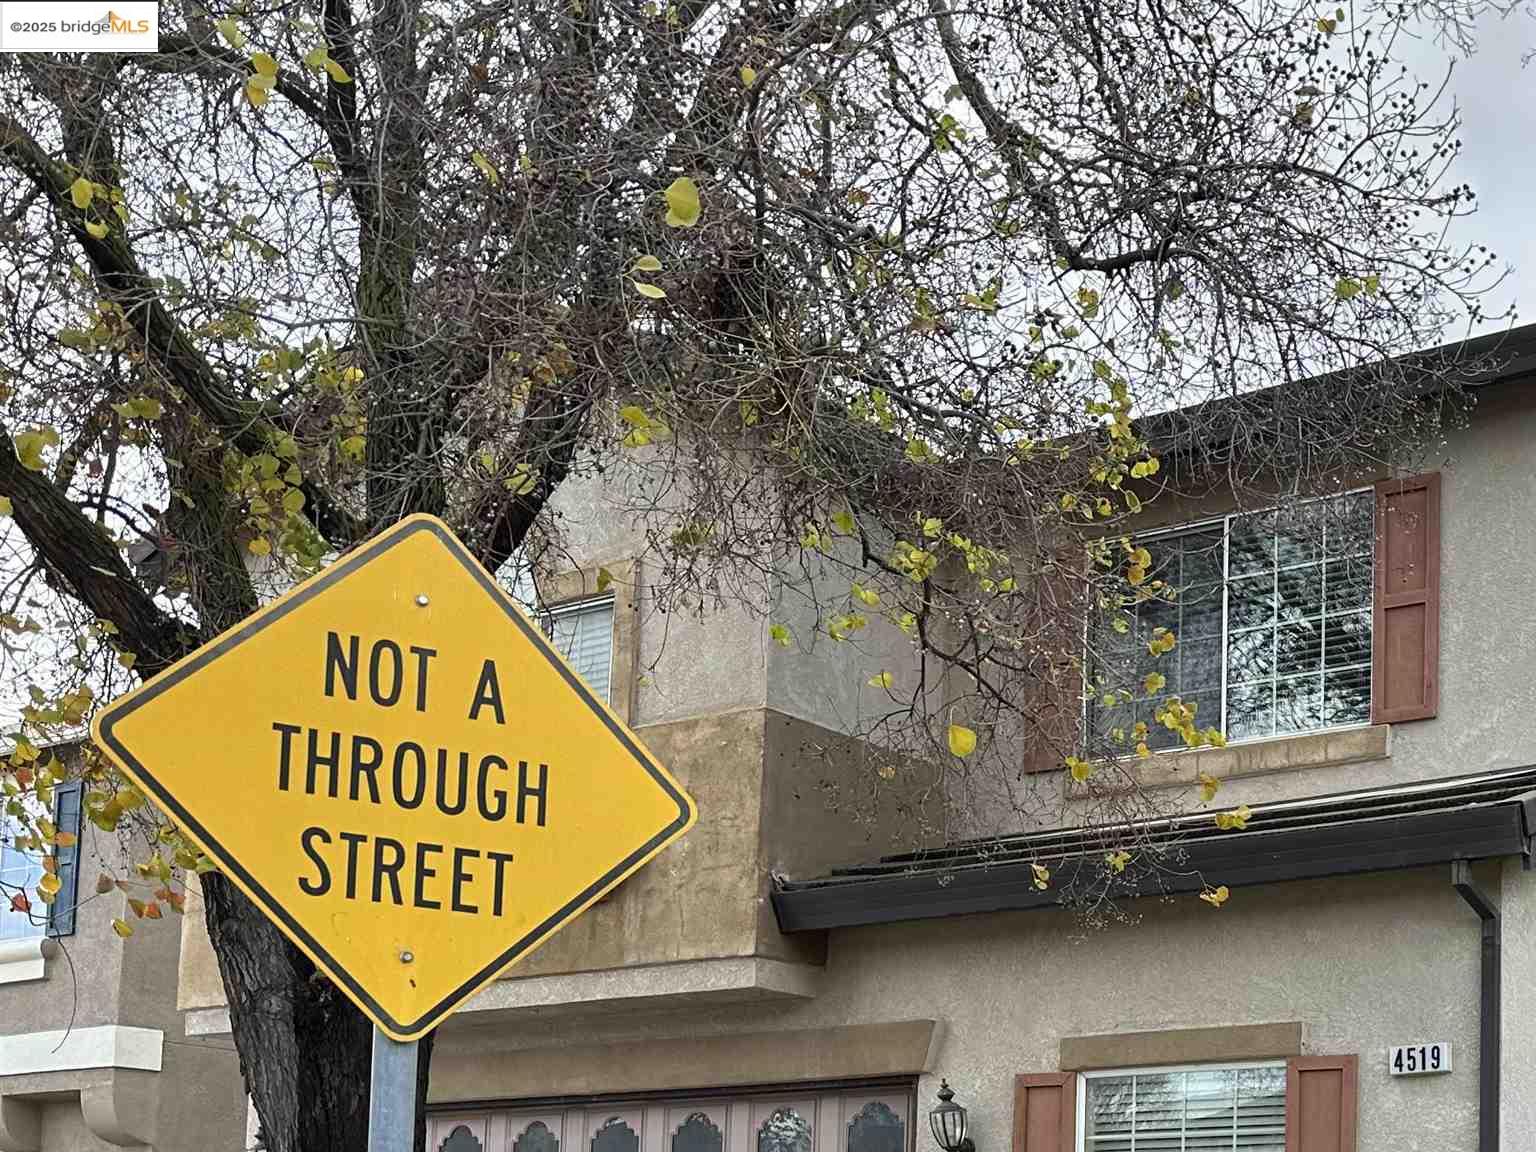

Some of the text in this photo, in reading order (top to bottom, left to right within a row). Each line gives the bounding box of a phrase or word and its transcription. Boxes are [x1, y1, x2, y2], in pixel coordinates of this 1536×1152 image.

[324, 631, 506, 724] NOT A
[272, 722, 548, 827] THROUGH
[298, 826, 514, 917] STREET
[1393, 1045, 1440, 1072] 4519
